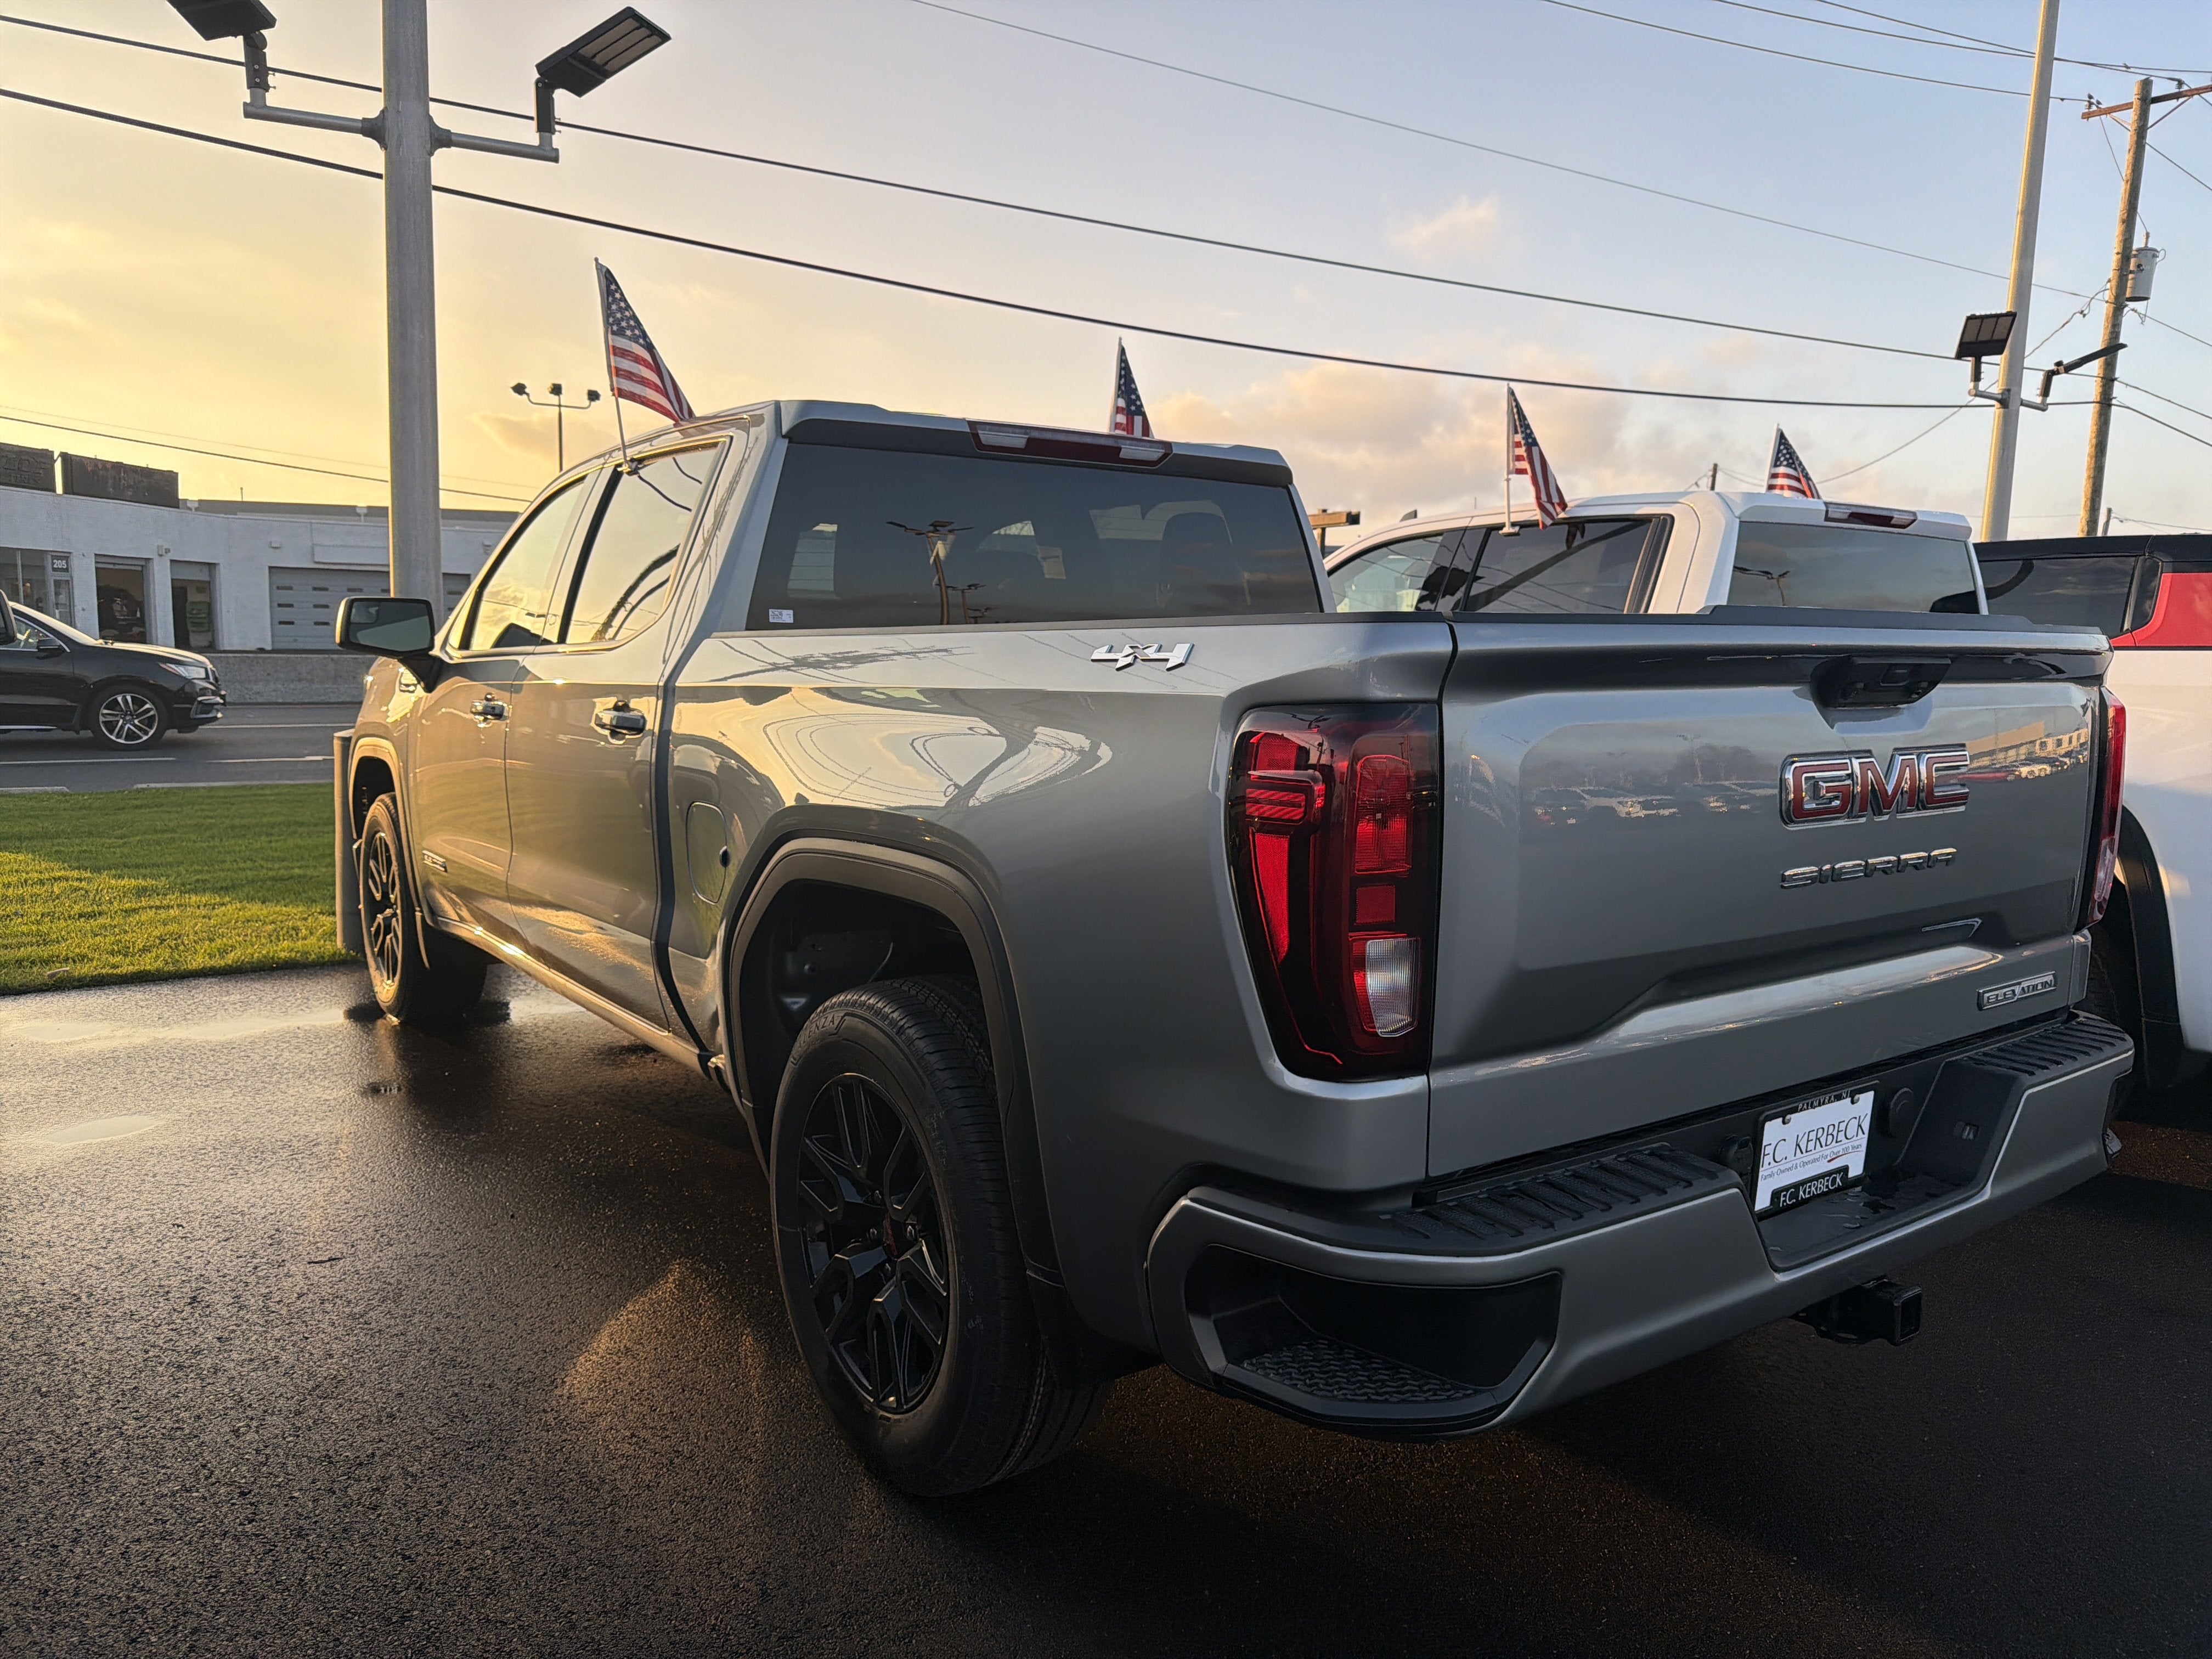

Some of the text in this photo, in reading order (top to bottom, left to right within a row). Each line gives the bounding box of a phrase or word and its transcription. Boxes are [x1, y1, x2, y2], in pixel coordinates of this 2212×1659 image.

[53, 560, 67, 569] 205
[1779, 743, 1970, 830] GMC
[1780, 848, 1958, 889] SIERRA
[1985, 979, 2055, 1005] ELEVATION
[1760, 1113, 1869, 1169] F.C. KERBECK
[1760, 1171, 1776, 1182] Family
[1776, 1164, 1795, 1176] Owned
[1799, 1154, 1821, 1169] Operated
[1829, 1149, 1841, 1158] Over
[1841, 1146, 1850, 1154] 100
[1850, 1143, 1863, 1152] Years
[1779, 1171, 1844, 1207] F.C. KERBECK
